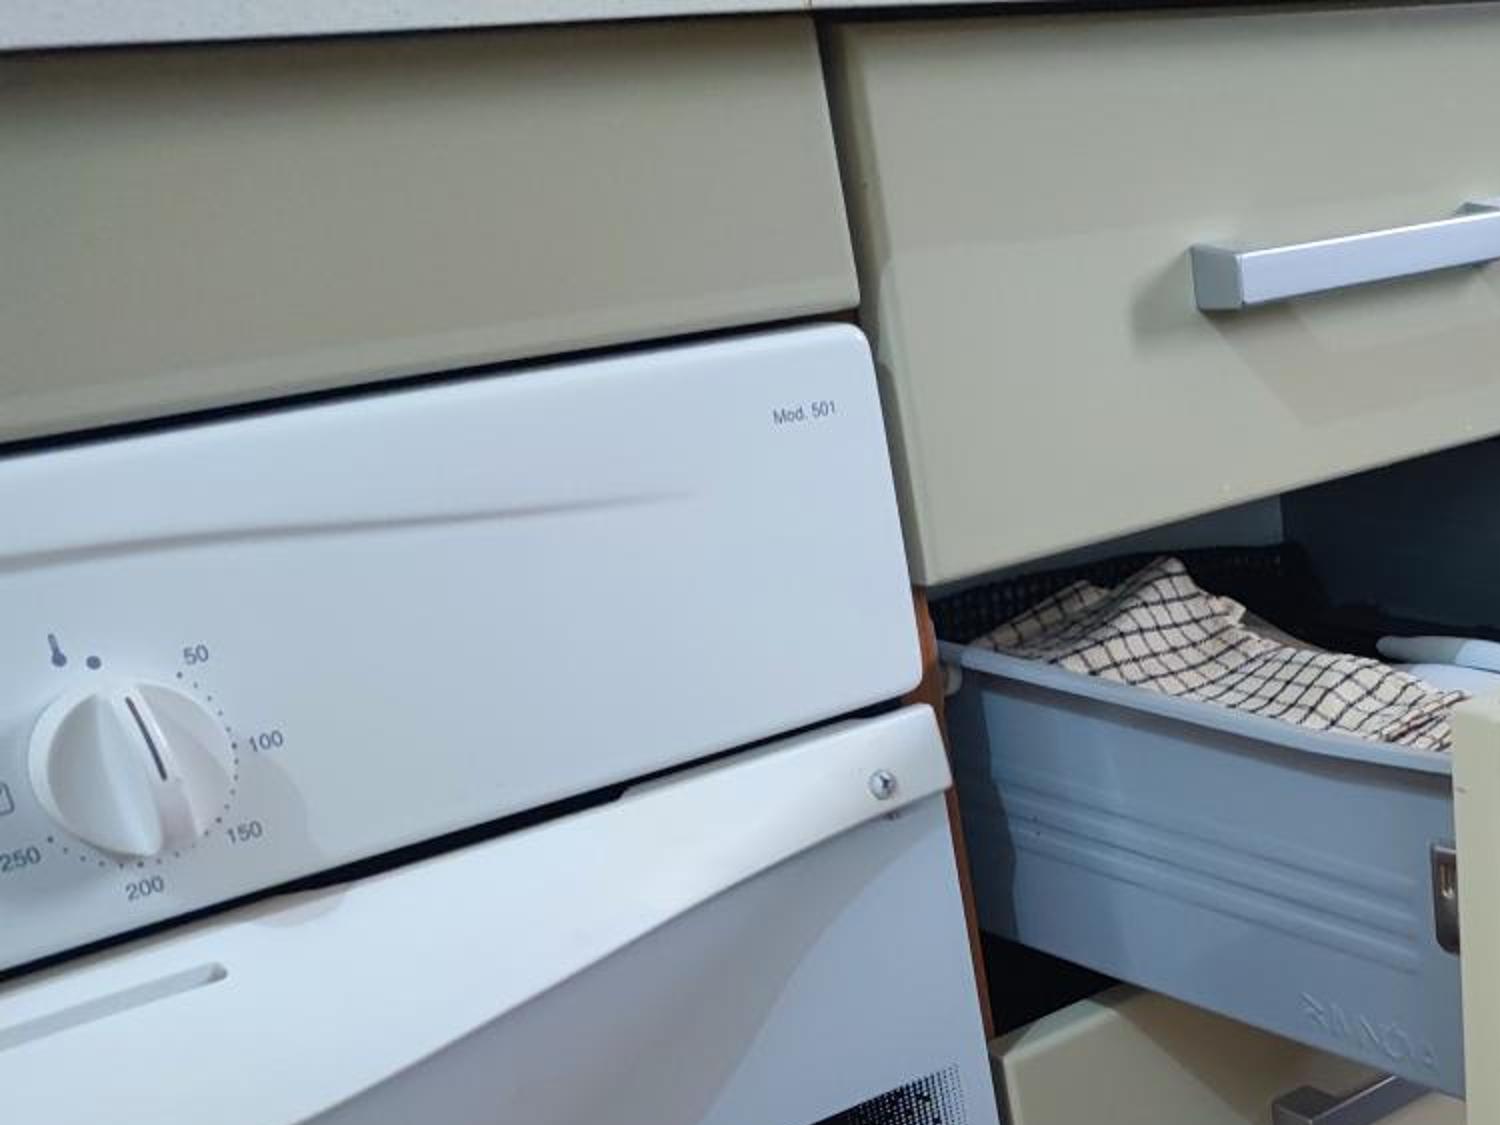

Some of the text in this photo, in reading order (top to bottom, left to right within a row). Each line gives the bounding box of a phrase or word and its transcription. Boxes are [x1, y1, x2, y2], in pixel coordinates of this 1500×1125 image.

[811, 400, 835, 418] 501
[183, 645, 209, 665] 50
[248, 730, 284, 752] 100
[227, 821, 263, 844] 150
[0, 847, 41, 873] 250
[125, 876, 165, 901] 200
